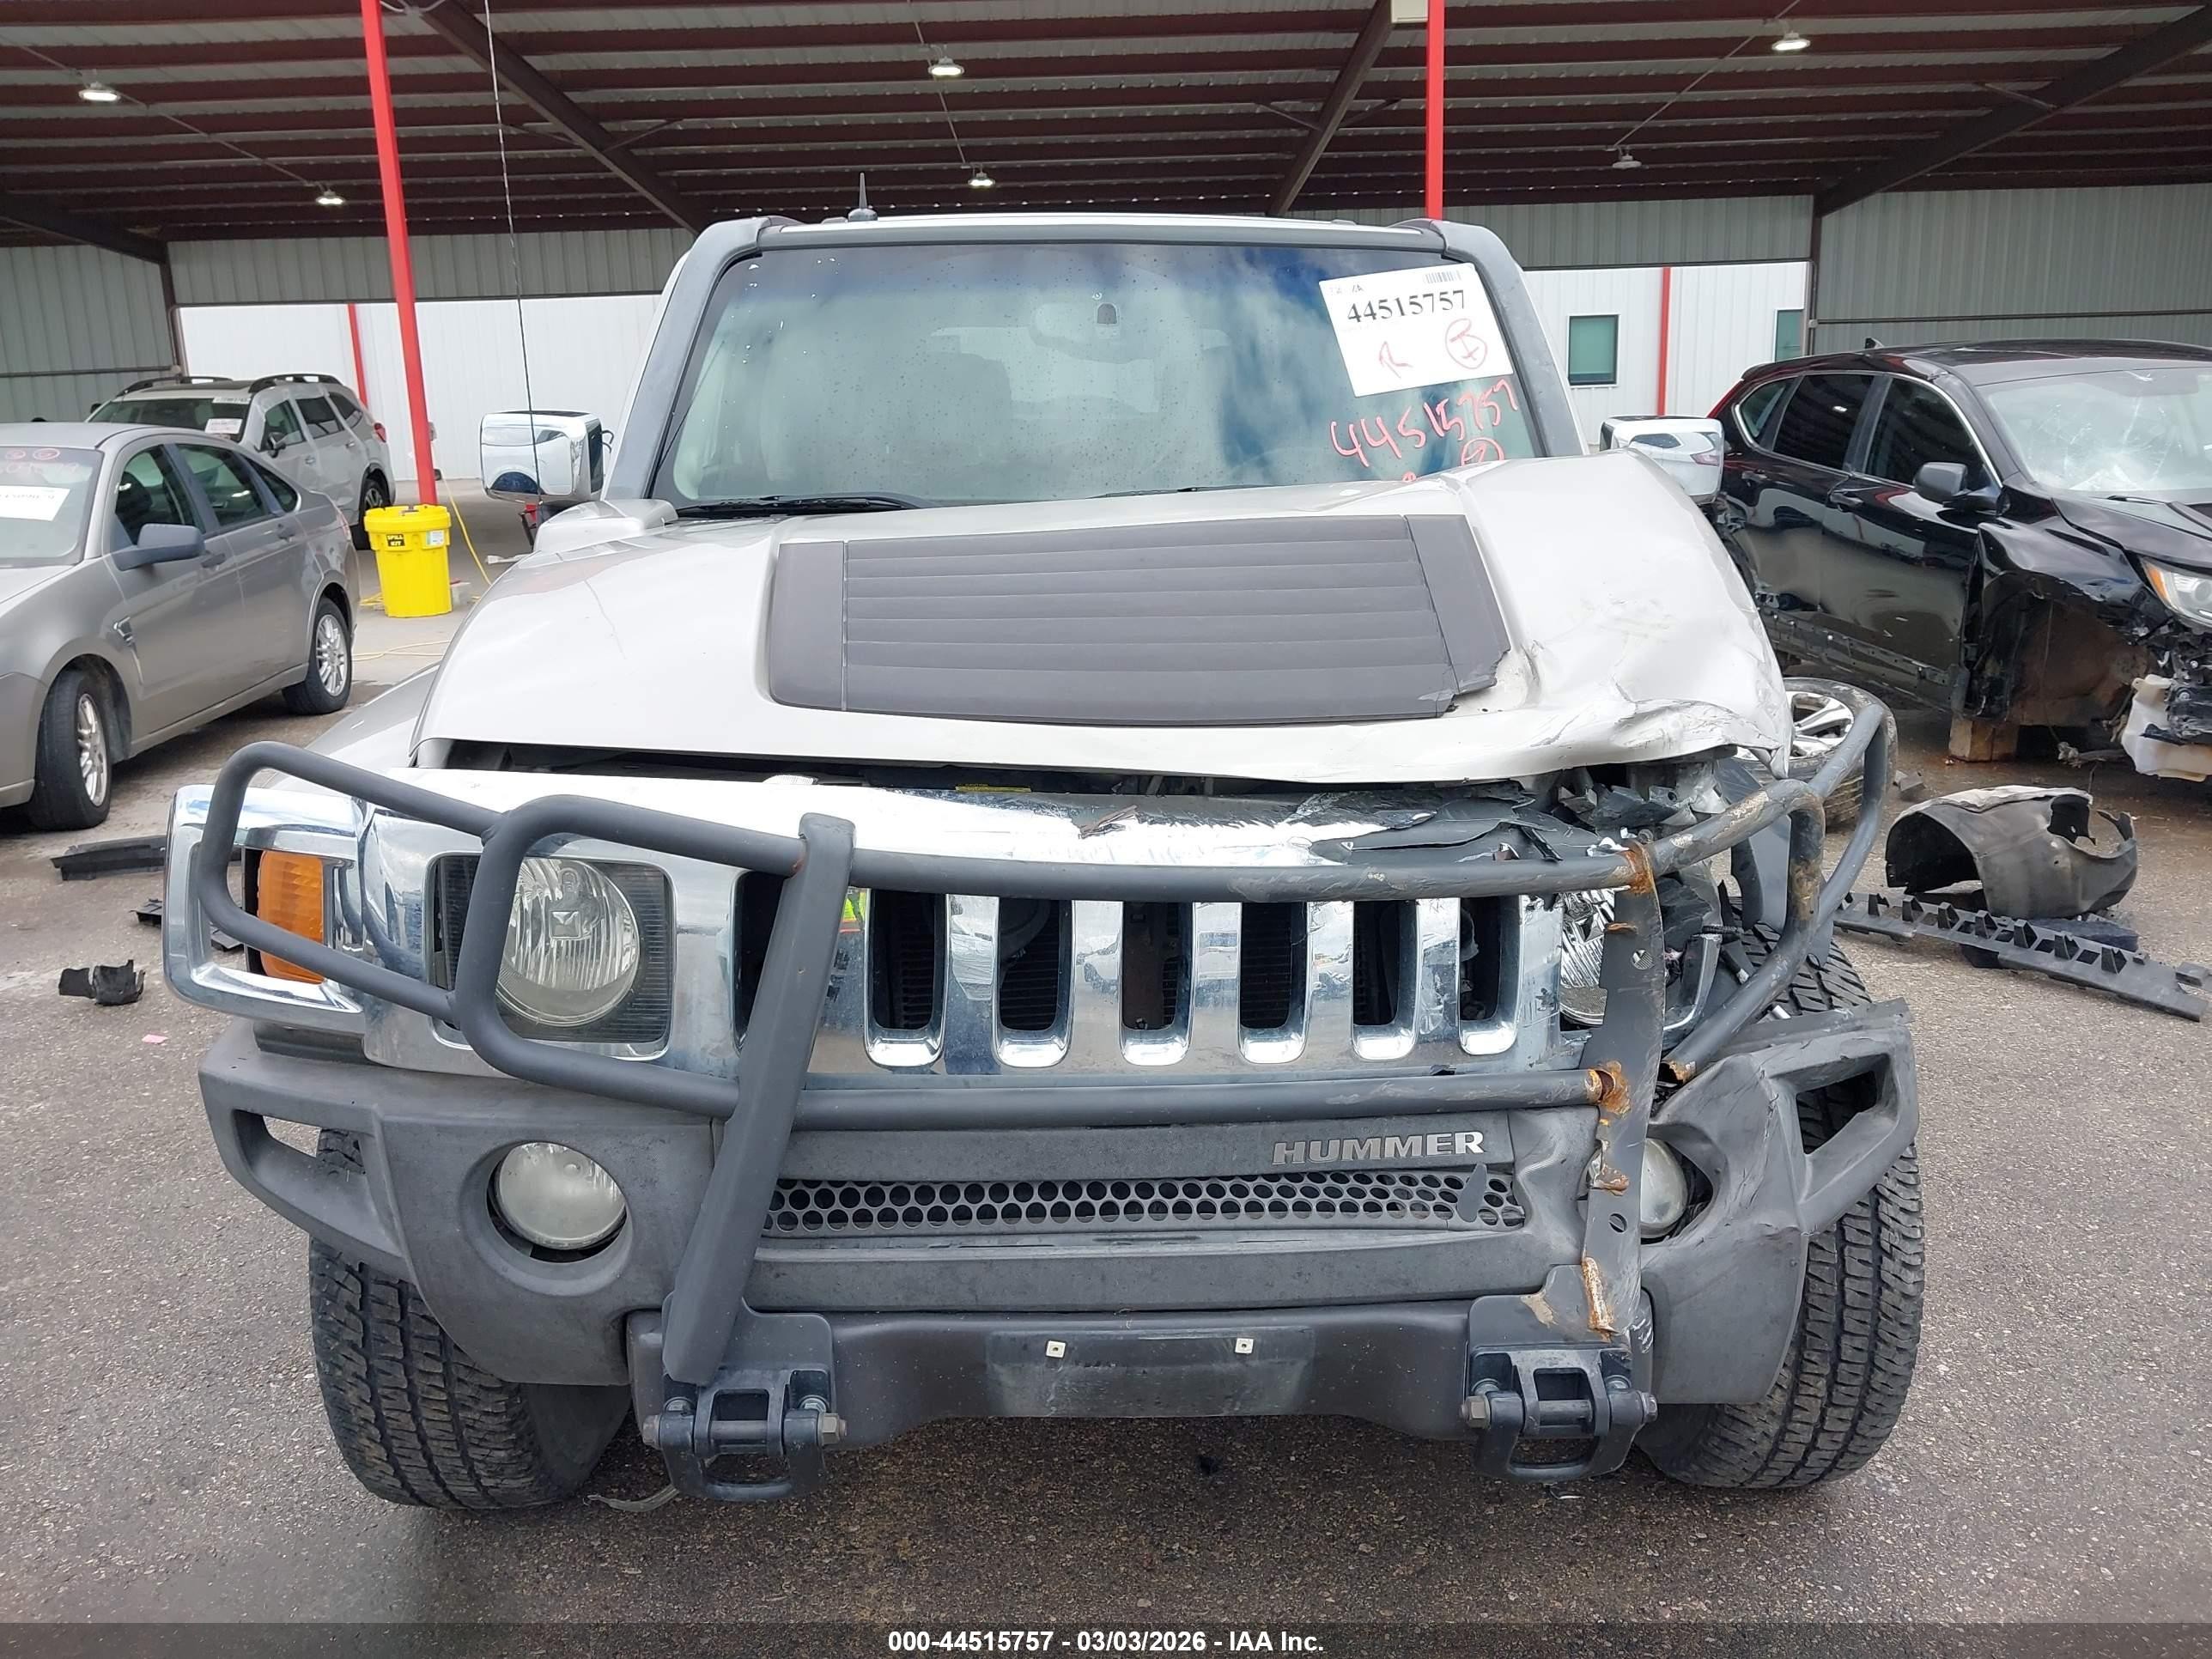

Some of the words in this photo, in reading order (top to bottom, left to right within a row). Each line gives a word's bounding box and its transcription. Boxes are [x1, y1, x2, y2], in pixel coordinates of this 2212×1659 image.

[1347, 289, 1465, 323] 44515757
[1331, 379, 1518, 467] 44515757
[1272, 1131, 1485, 1165] HUMMER
